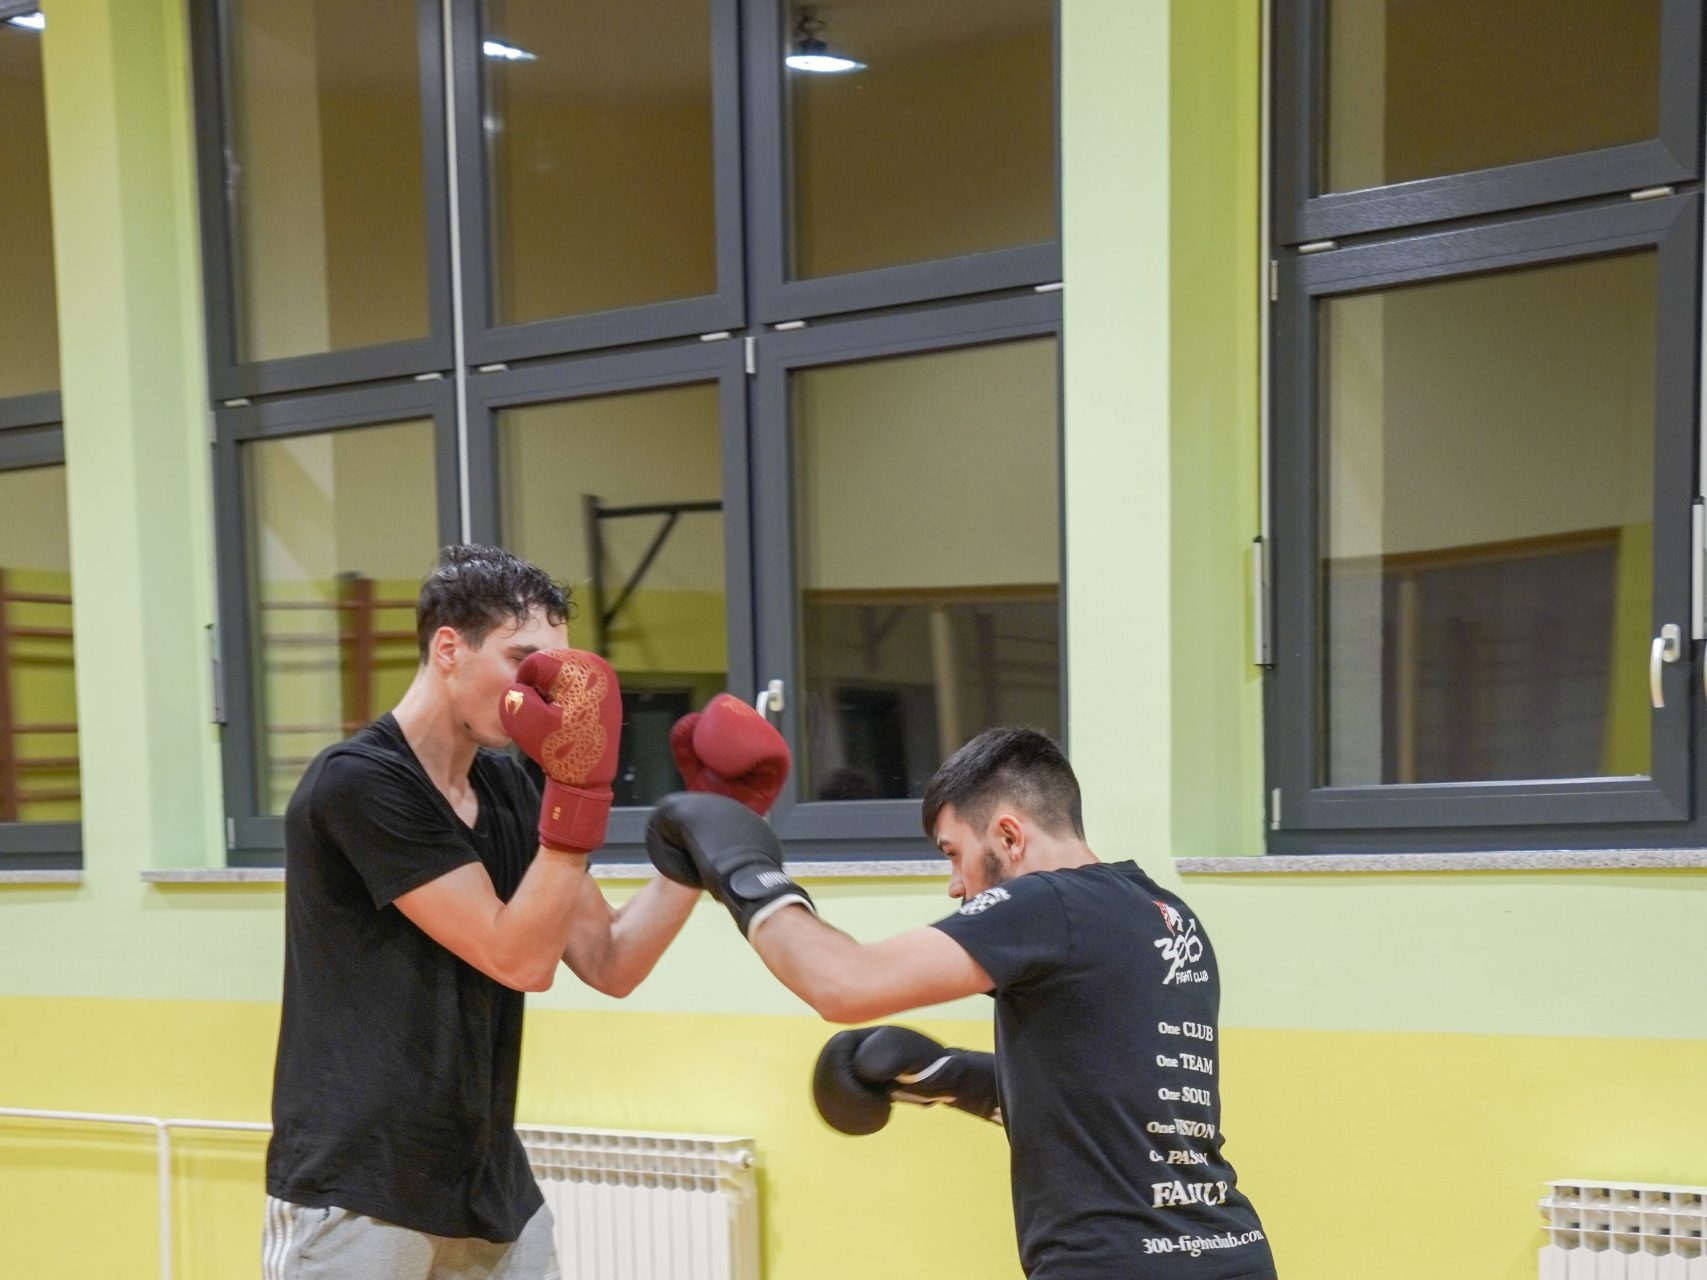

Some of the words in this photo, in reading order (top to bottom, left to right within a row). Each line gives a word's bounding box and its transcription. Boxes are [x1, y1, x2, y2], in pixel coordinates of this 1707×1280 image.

[1158, 1021, 1181, 1035] One
[1182, 1021, 1214, 1042] CLUB
[1156, 1054, 1179, 1068] One
[1179, 1053, 1213, 1075] TEAM
[1158, 1087, 1181, 1101] One
[1146, 1121, 1176, 1134] One
